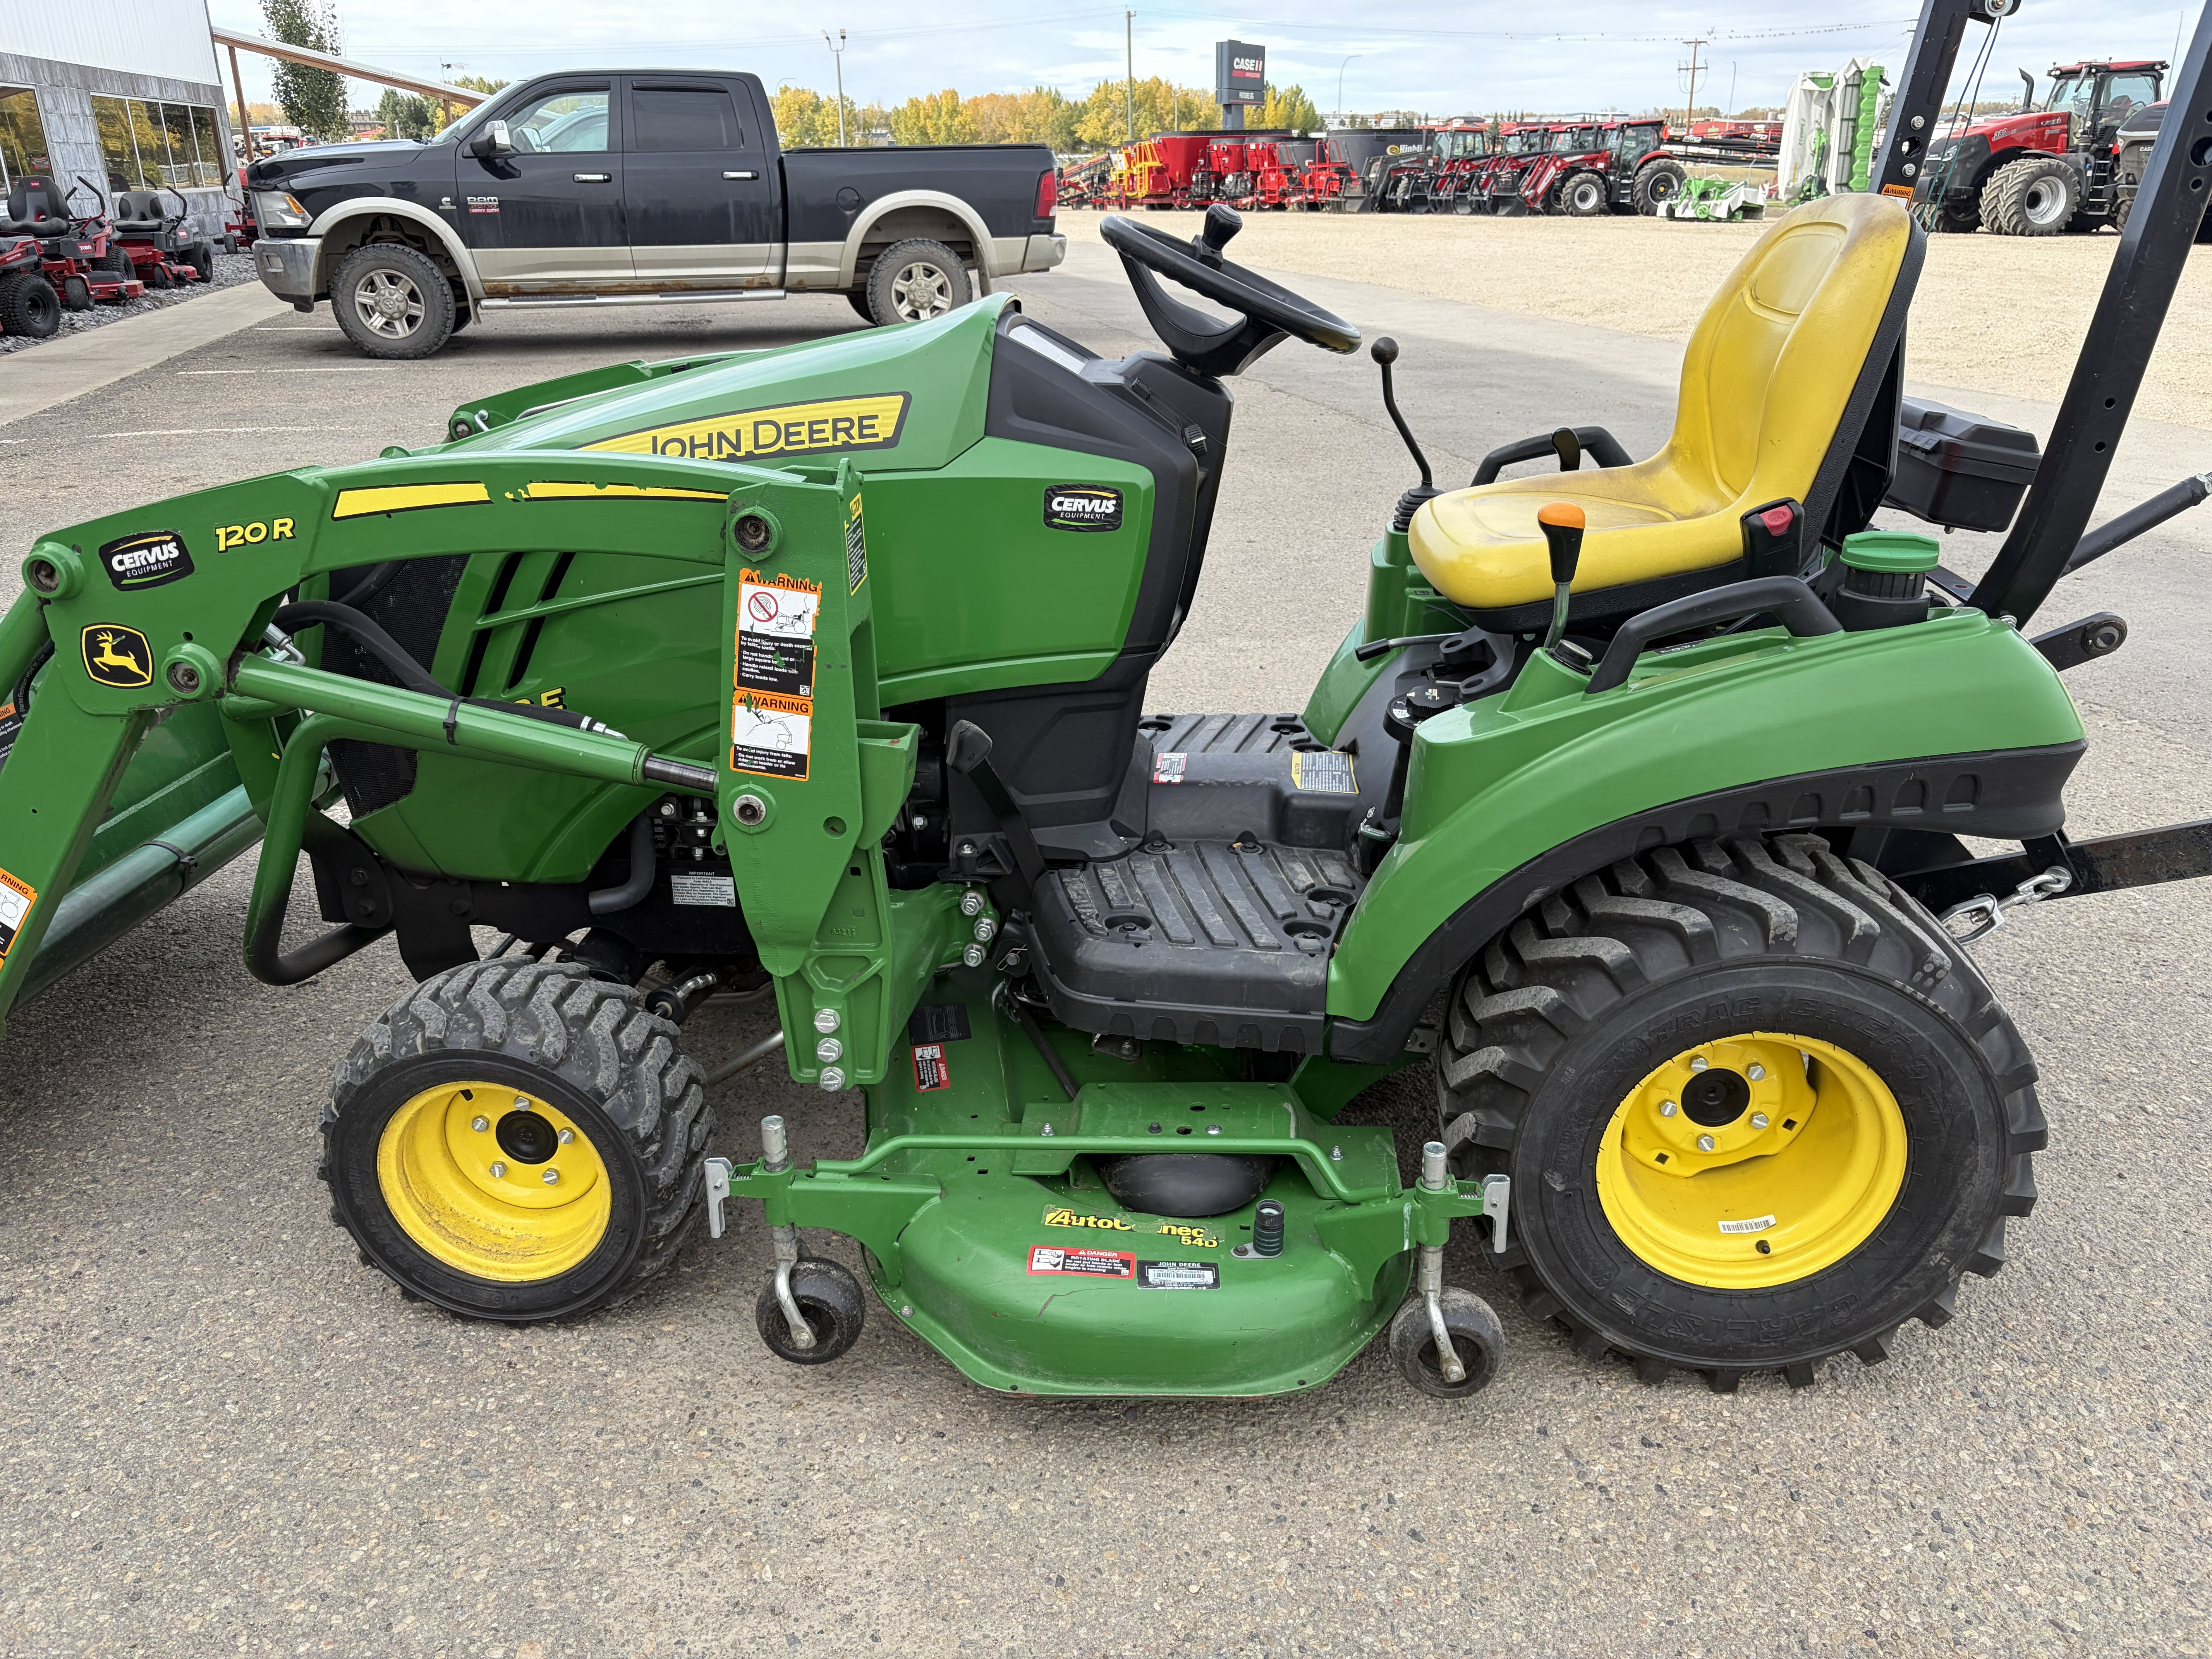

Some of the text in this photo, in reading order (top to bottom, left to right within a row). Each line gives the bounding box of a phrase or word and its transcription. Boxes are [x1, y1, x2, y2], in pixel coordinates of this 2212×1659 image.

[1233, 57, 1255, 70] CASE
[1995, 128, 2007, 137] 380
[1400, 144, 1432, 153] Highlie
[1890, 188, 1911, 196] WARNING
[652, 414, 879, 457] JOHN DEERE
[1051, 497, 1116, 514] CERVUS
[1769, 513, 1786, 523] PUSH
[112, 542, 179, 572] CERVUS
[127, 560, 173, 577] EQUIPMENT
[753, 696, 809, 713] WARNING
[1, 874, 29, 895] RNING
[1649, 996, 1913, 1049] TRAC CHIEF
[1609, 1285, 1862, 1343] CARLISLE
